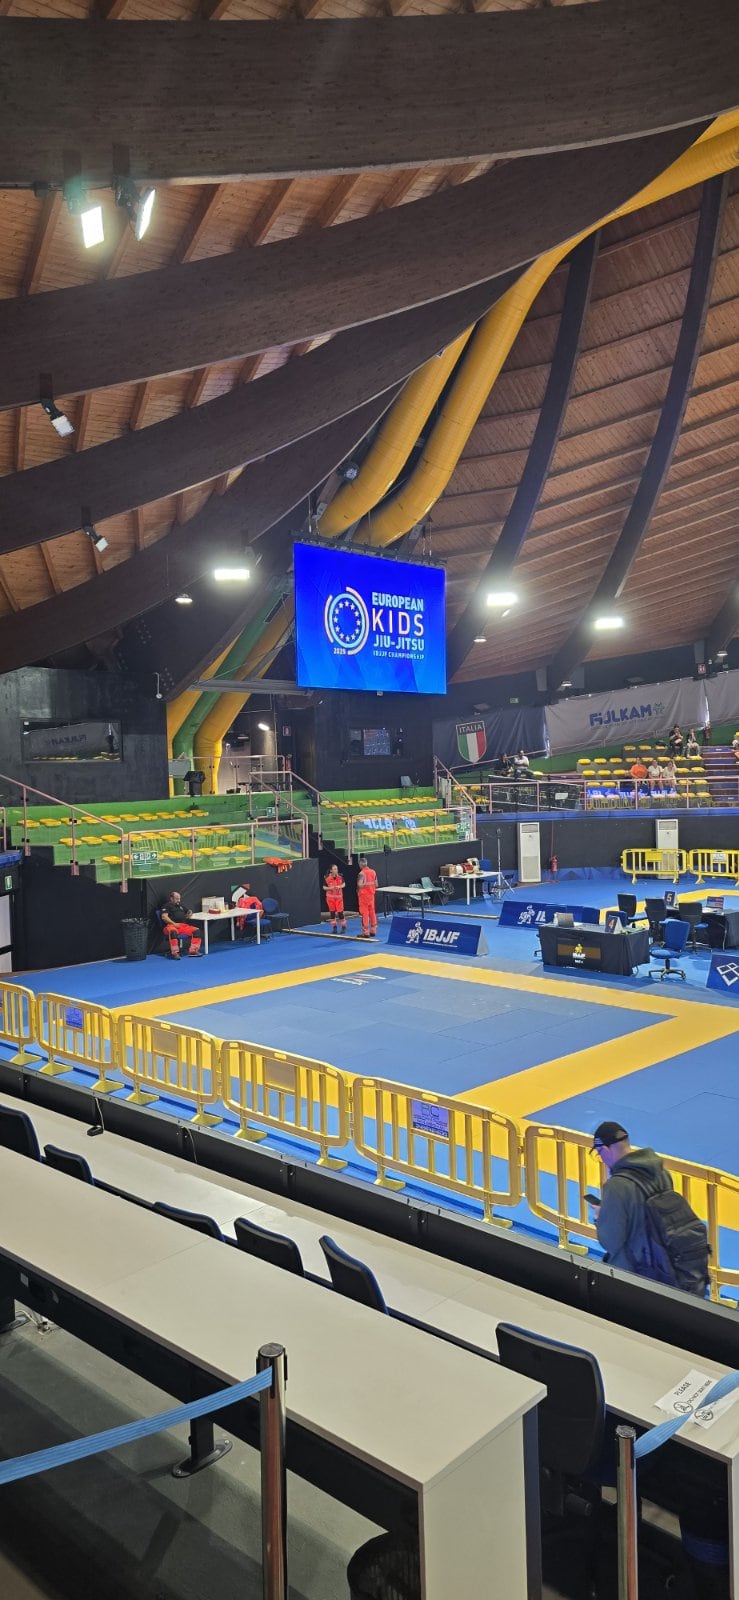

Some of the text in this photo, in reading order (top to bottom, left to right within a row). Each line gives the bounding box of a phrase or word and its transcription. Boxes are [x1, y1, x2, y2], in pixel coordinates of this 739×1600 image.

[372, 591, 424, 612] EUROPEAN
[372, 608, 424, 637] KIDS
[373, 634, 425, 651] JIU-JITSU
[459, 723, 482, 734] ITALIA
[666, 893, 673, 902] 5
[608, 918, 615, 929] 4
[423, 928, 460, 943] IBJJF
[673, 1382, 691, 1396] PLEASE
